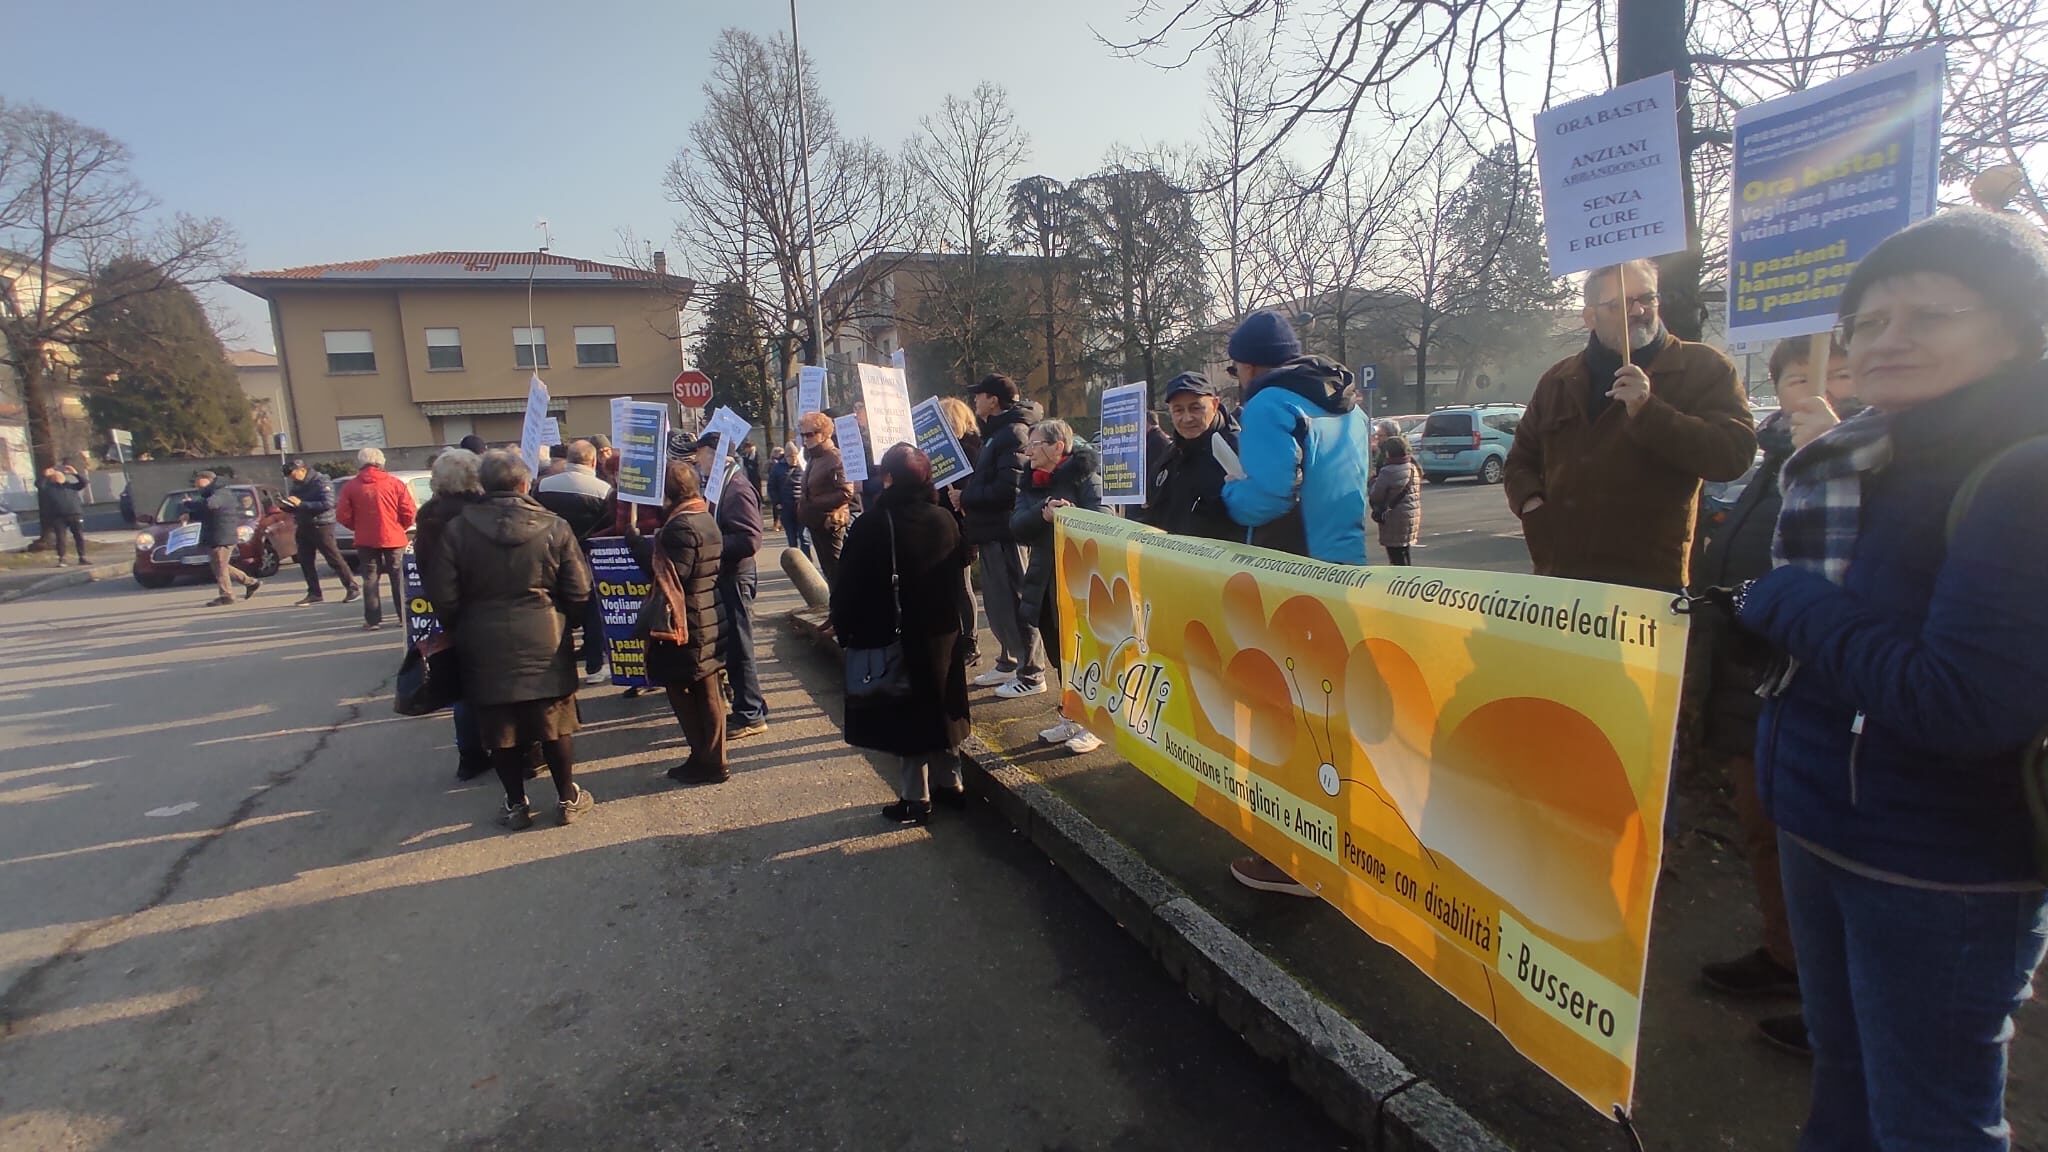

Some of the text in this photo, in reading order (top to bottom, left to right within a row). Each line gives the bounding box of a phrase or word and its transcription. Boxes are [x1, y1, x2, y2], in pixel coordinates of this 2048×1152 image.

[1556, 98, 1659, 136] ORA BASTA
[1570, 139, 1649, 169] ANZIANI
[1561, 154, 1664, 187] ABBANDONATI
[1743, 176, 1796, 201] Ora
[1802, 143, 1900, 188] basta!
[1583, 190, 1643, 212] SENZA
[1741, 170, 1897, 223] Vogliamo Medici
[1589, 208, 1640, 229] CURE
[1740, 197, 1898, 242] vicini alle persone
[1570, 221, 1665, 252] E RICETTE
[1752, 239, 1847, 278] pazienti
[1738, 261, 1858, 294] hanno per
[1737, 295, 1757, 312] la
[675, 382, 710, 397] STOP
[1363, 367, 1375, 388] P
[1103, 422, 1138, 436] Ora basta!
[599, 581, 652, 596] Ora bas
[1230, 552, 1373, 589] www.associazioneleali.it
[1386, 575, 1657, 647] info@associazioneleali.it
[604, 613, 627, 625] vicini
[616, 638, 645, 652] pazi
[613, 665, 645, 678] la paz
[1068, 633, 1171, 744] Le Ali
[1165, 731, 1221, 784] Associazione
[1223, 765, 1280, 822] Famigliari
[1284, 808, 1290, 828] e
[1294, 807, 1333, 852] Amici
[1344, 831, 1386, 884] Persone
[1395, 871, 1417, 903] con
[1424, 882, 1491, 952] disabilità
[1517, 941, 1616, 1038] Bussero
